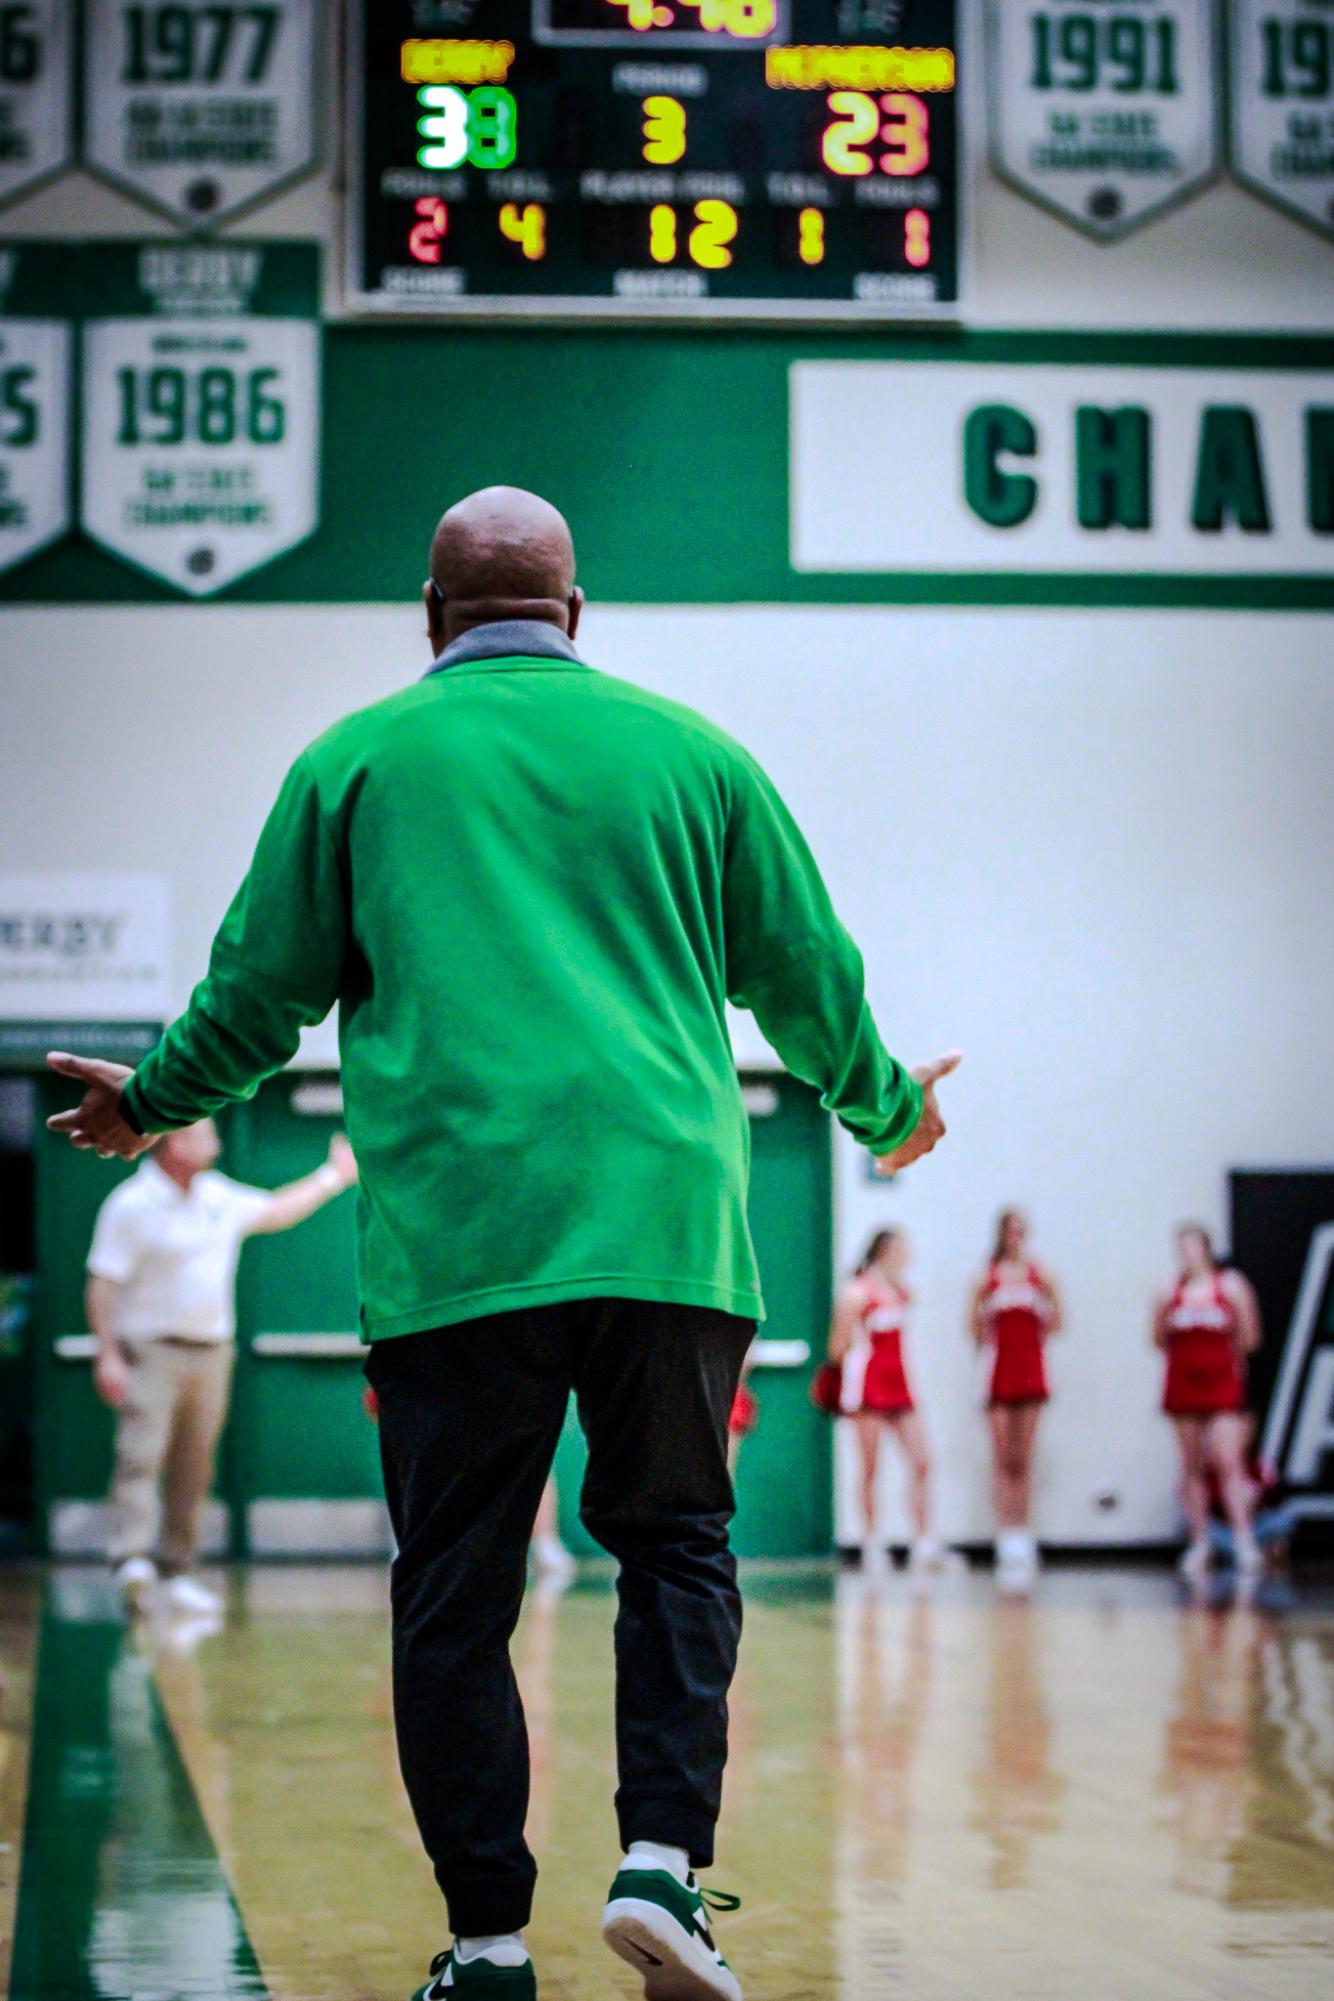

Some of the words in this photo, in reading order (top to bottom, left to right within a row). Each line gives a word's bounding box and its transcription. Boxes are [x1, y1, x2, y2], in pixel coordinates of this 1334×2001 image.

[124, 5, 279, 84] 1977
[1031, 12, 1178, 94] 1991
[416, 85, 517, 169] 38
[642, 96, 687, 164] 3
[822, 91, 930, 176] 23
[409, 197, 448, 263] 2
[499, 203, 546, 260] 4
[799, 207, 825, 265] 1
[904, 208, 930, 267] 1
[117, 367, 286, 445] 1986
